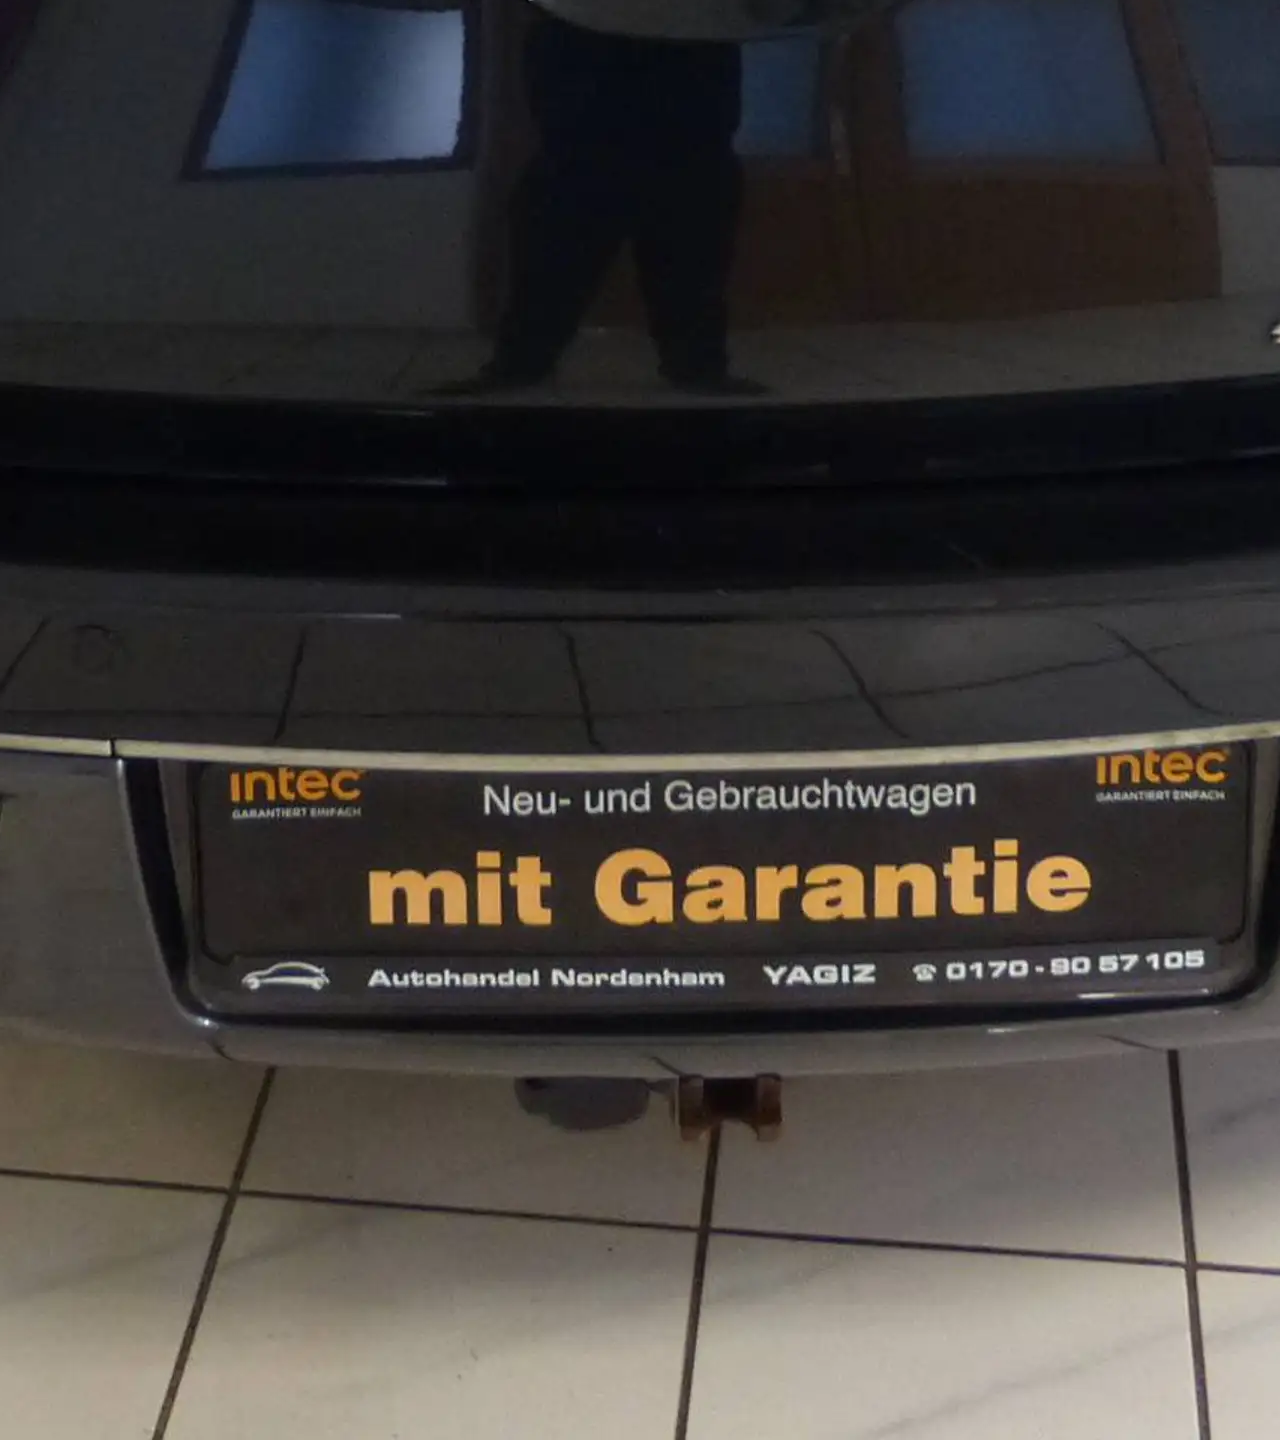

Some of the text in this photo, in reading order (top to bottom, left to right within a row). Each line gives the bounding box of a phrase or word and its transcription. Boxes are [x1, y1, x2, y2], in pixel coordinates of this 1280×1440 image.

[230, 766, 362, 802] intec
[1096, 748, 1228, 785] intec
[483, 777, 977, 816] Neu- und Gebrauchtwagen
[368, 839, 1092, 927] mit Garantie
[367, 968, 540, 987] Autohandel
[551, 968, 725, 987] Nordenham
[762, 963, 877, 986] YAGIZ
[945, 959, 1029, 981] 0170
